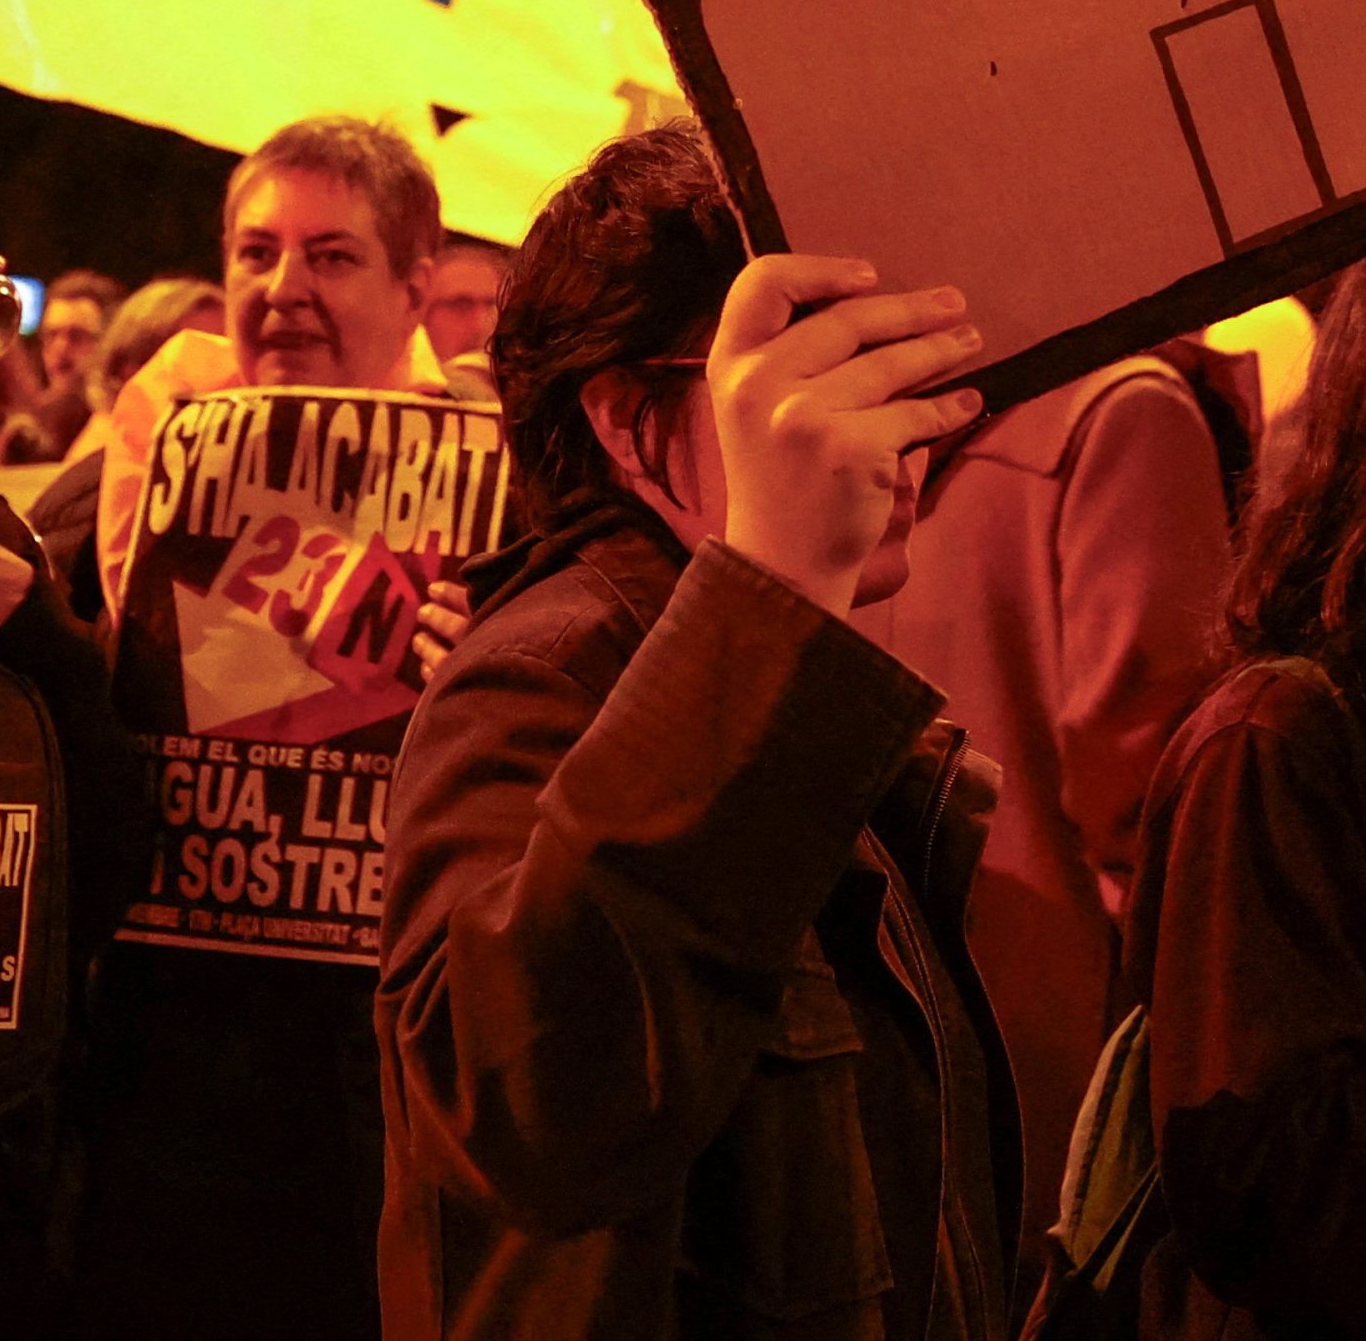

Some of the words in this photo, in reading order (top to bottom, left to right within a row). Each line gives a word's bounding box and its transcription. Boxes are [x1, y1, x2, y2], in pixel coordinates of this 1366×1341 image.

[148, 399, 272, 538] S'HA
[286, 400, 499, 557] ACABAT
[207, 739, 239, 762] EL
[247, 744, 303, 769] QUE
[350, 752, 397, 775] NO
[161, 761, 284, 846] GUA,
[301, 773, 389, 844] LLU
